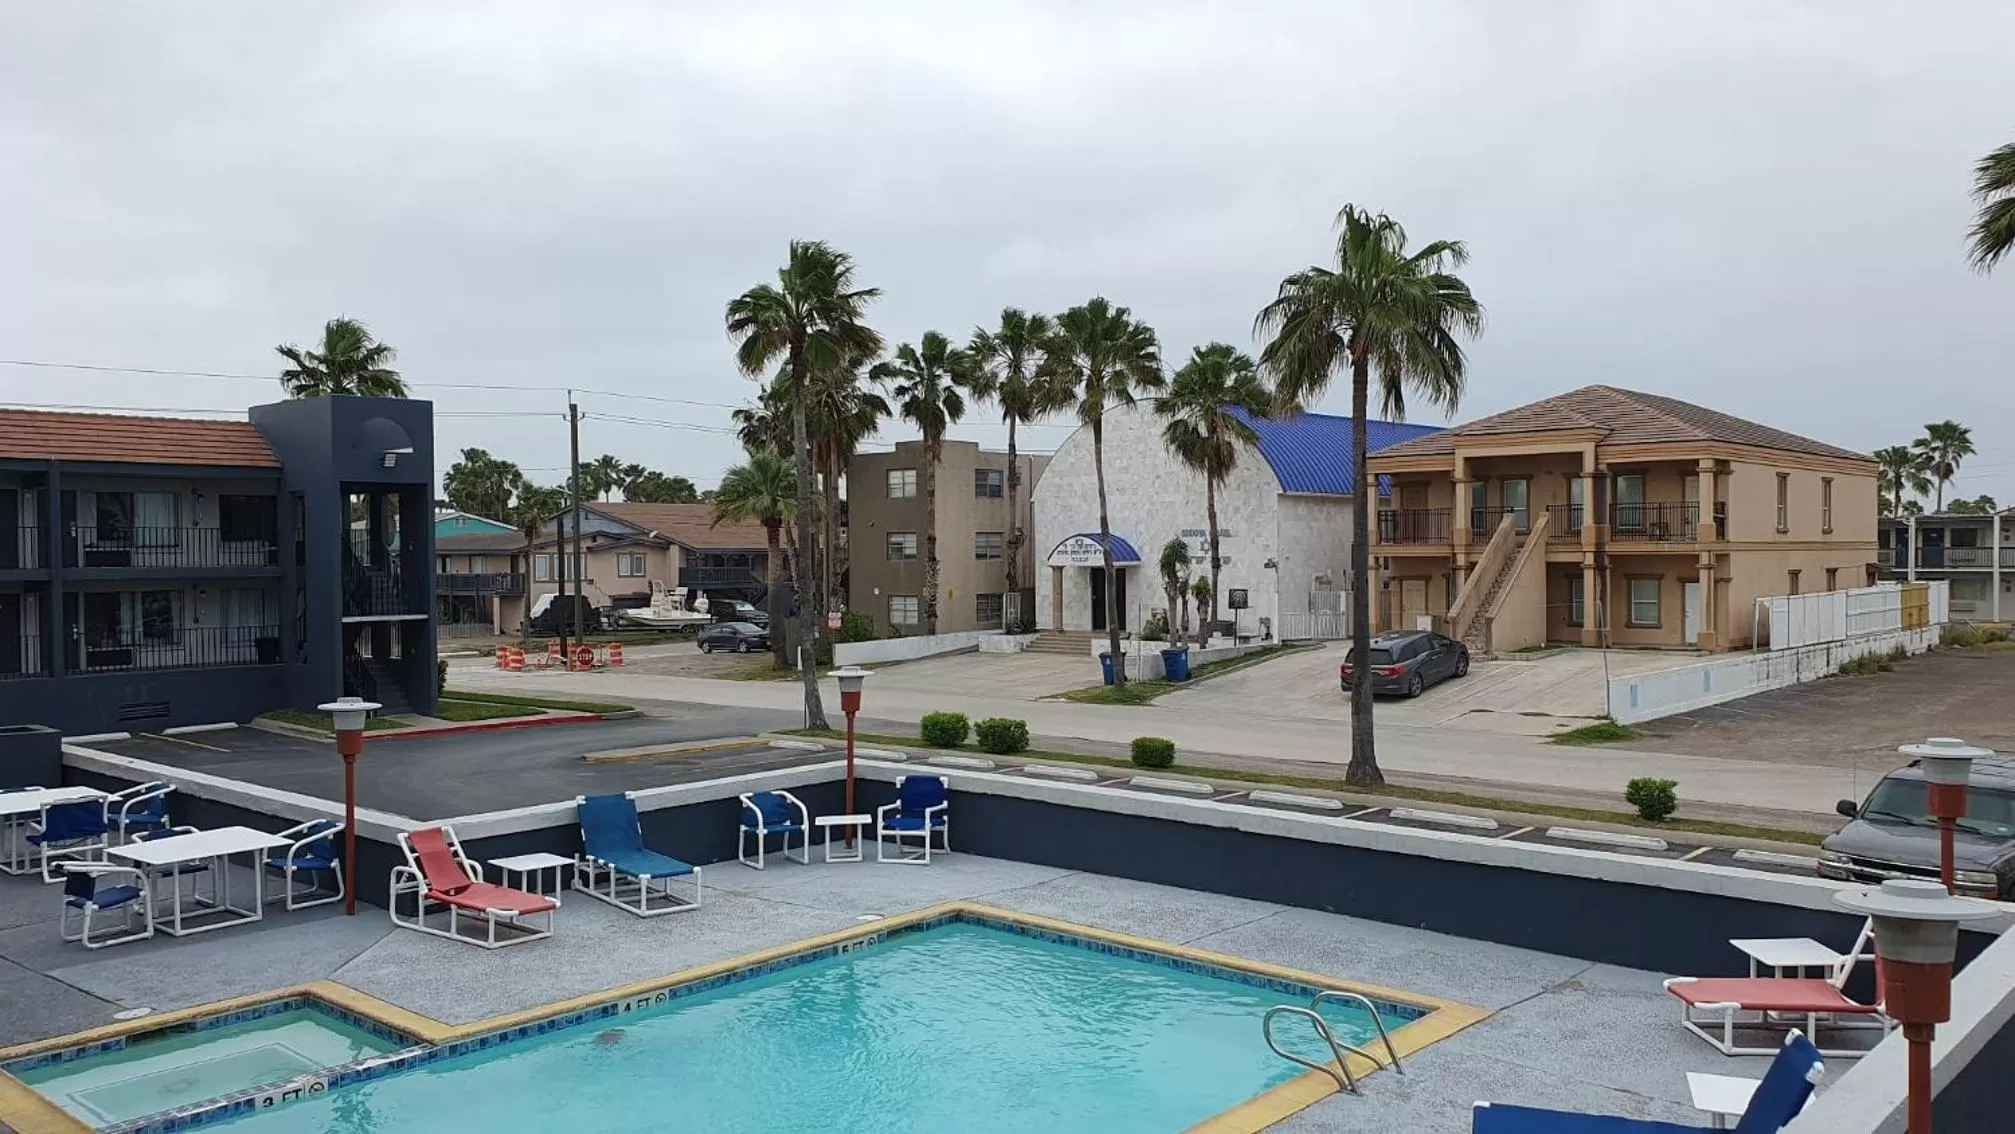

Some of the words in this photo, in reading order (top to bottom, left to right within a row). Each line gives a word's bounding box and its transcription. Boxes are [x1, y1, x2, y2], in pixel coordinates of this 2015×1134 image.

[578, 653, 592, 661] STOP
[624, 1002, 631, 1012] 4
[637, 997, 650, 1008] FT
[282, 1088, 302, 1102] FT
